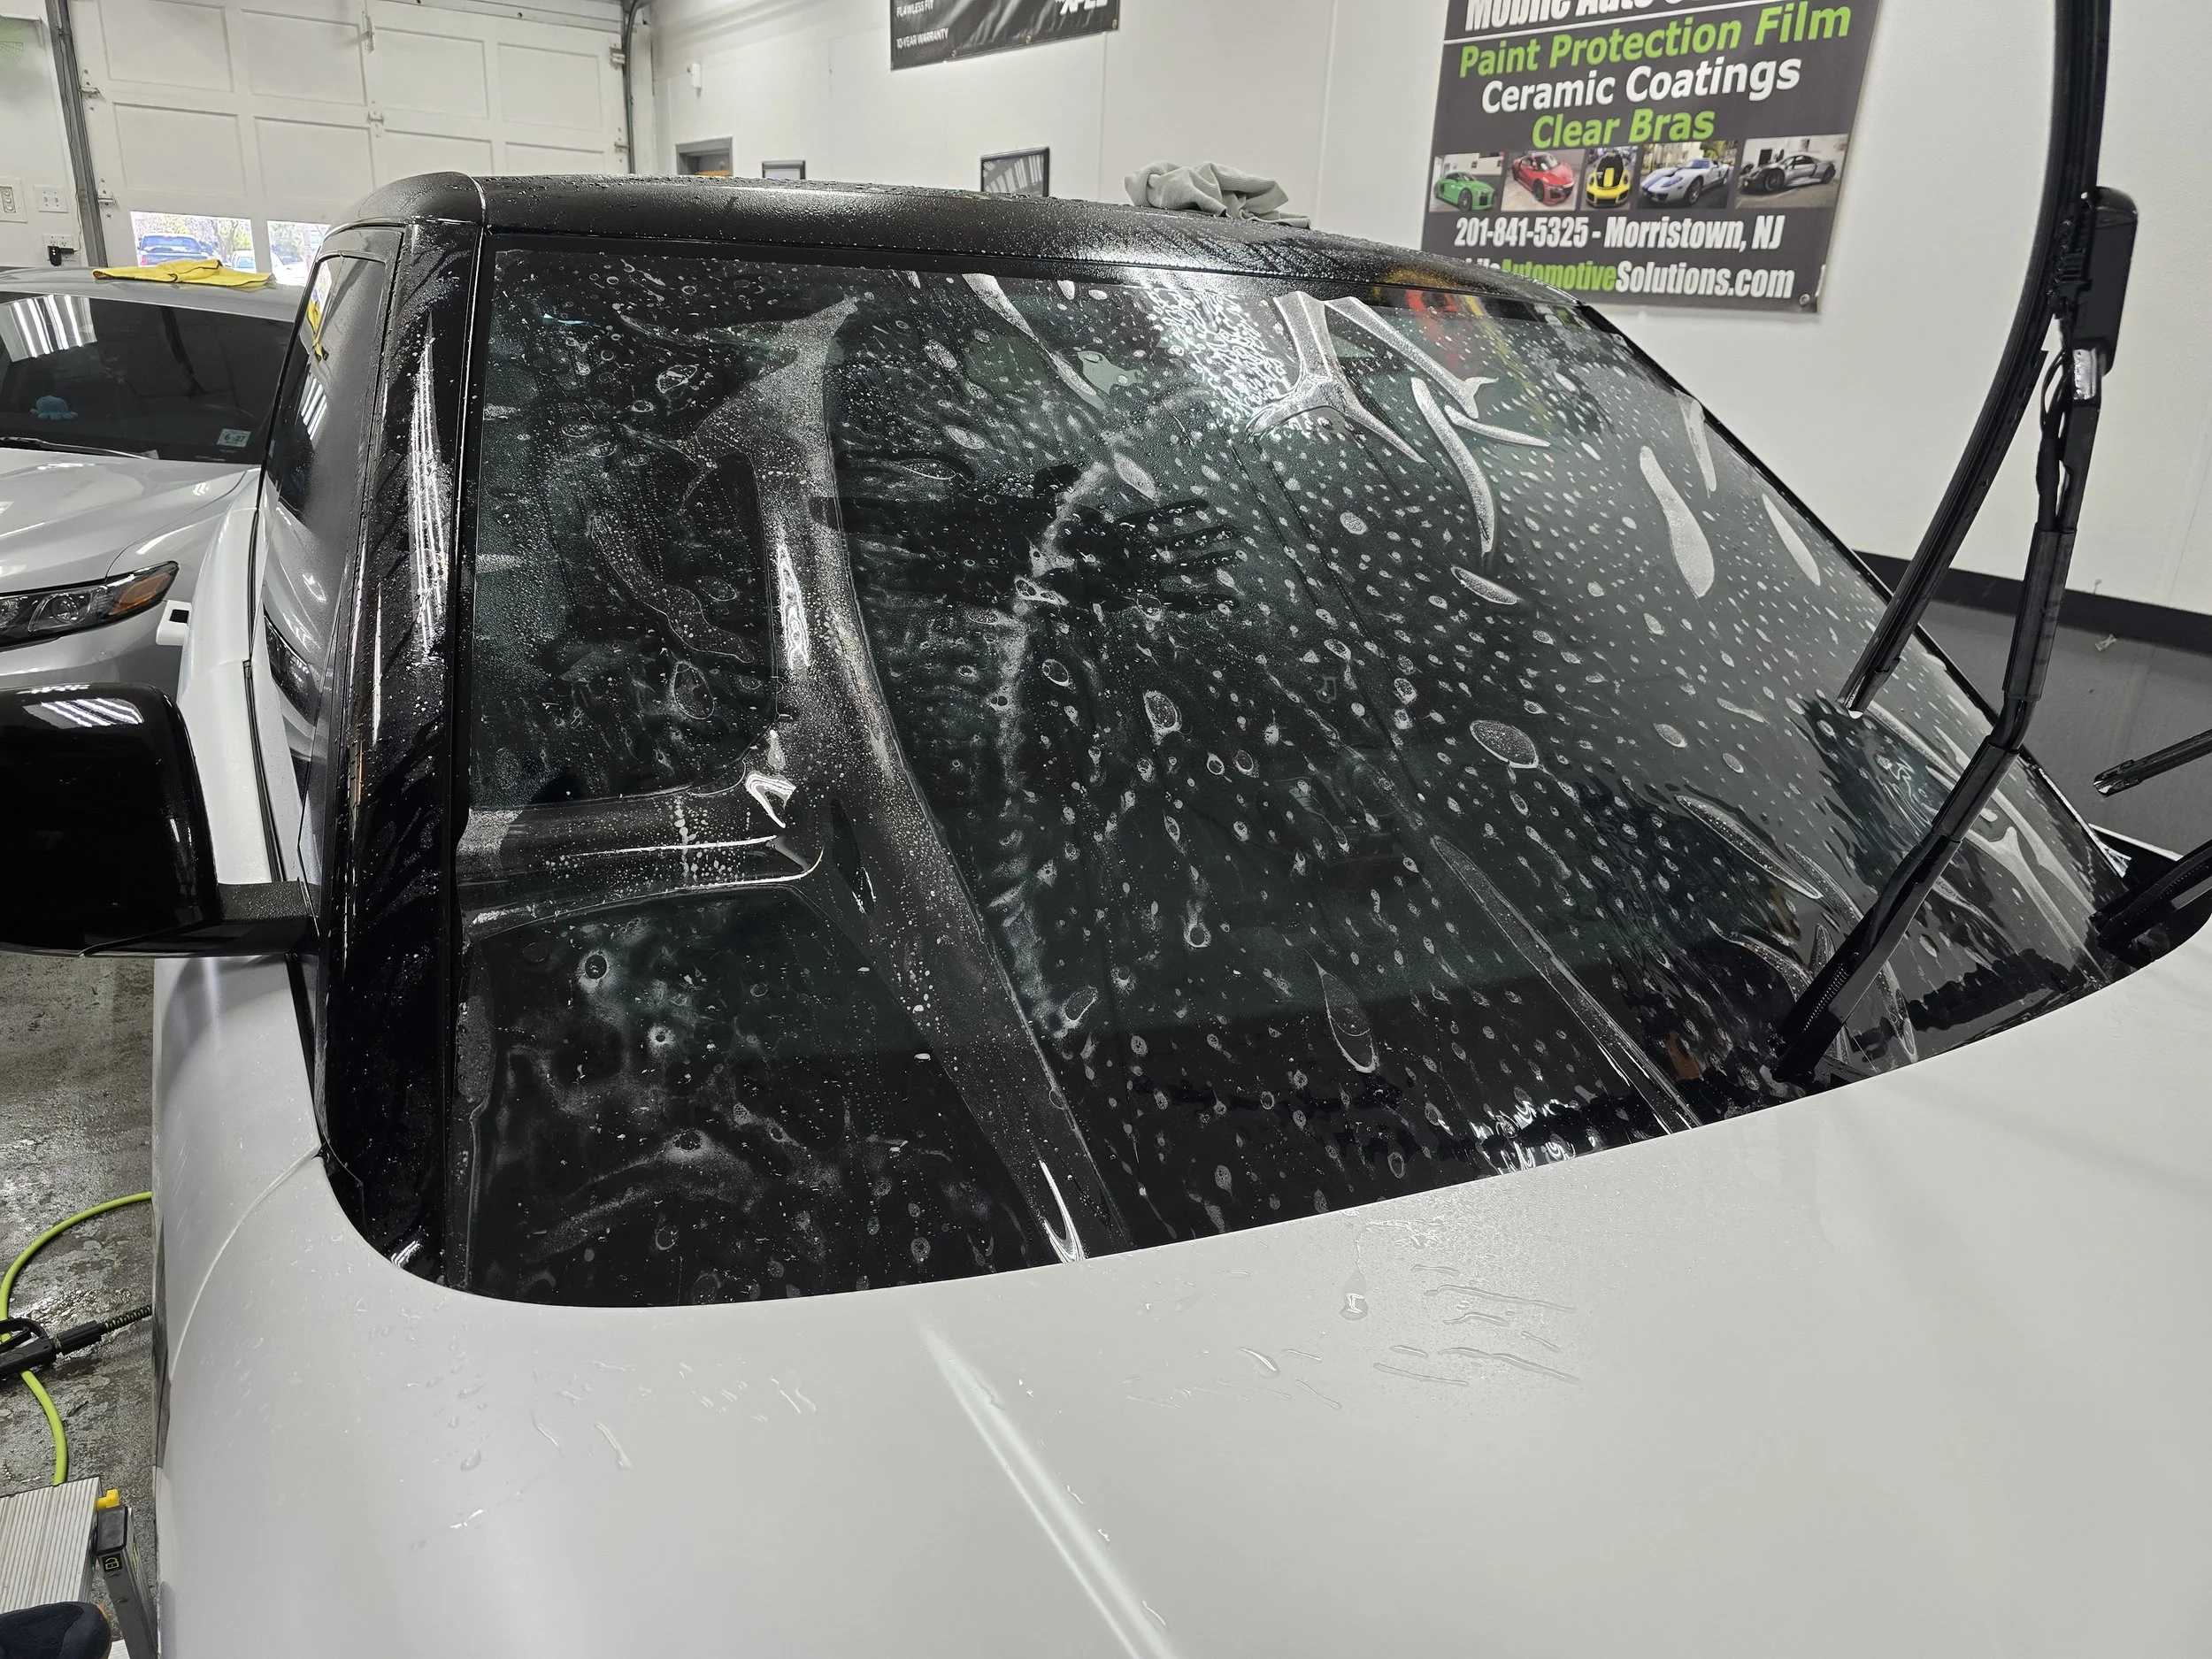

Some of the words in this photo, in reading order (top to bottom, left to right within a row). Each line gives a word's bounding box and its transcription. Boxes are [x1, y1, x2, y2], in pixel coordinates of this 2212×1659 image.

[896, 1, 925, 18] FLAWLESS
[918, 27, 949, 44] WARRANTY
[1459, 39, 1540, 78] Paint
[1548, 18, 1741, 68] Protection
[1754, 1, 1852, 45] Film
[1481, 70, 1614, 114] Ceramic
[1625, 57, 1801, 102] Coatings
[1532, 114, 1621, 150] Clear
[1629, 108, 1716, 144] Bras
[1454, 217, 1590, 248] 201-841-5325
[1603, 217, 1747, 251] Morristown,
[1751, 215, 1786, 250] NJ
